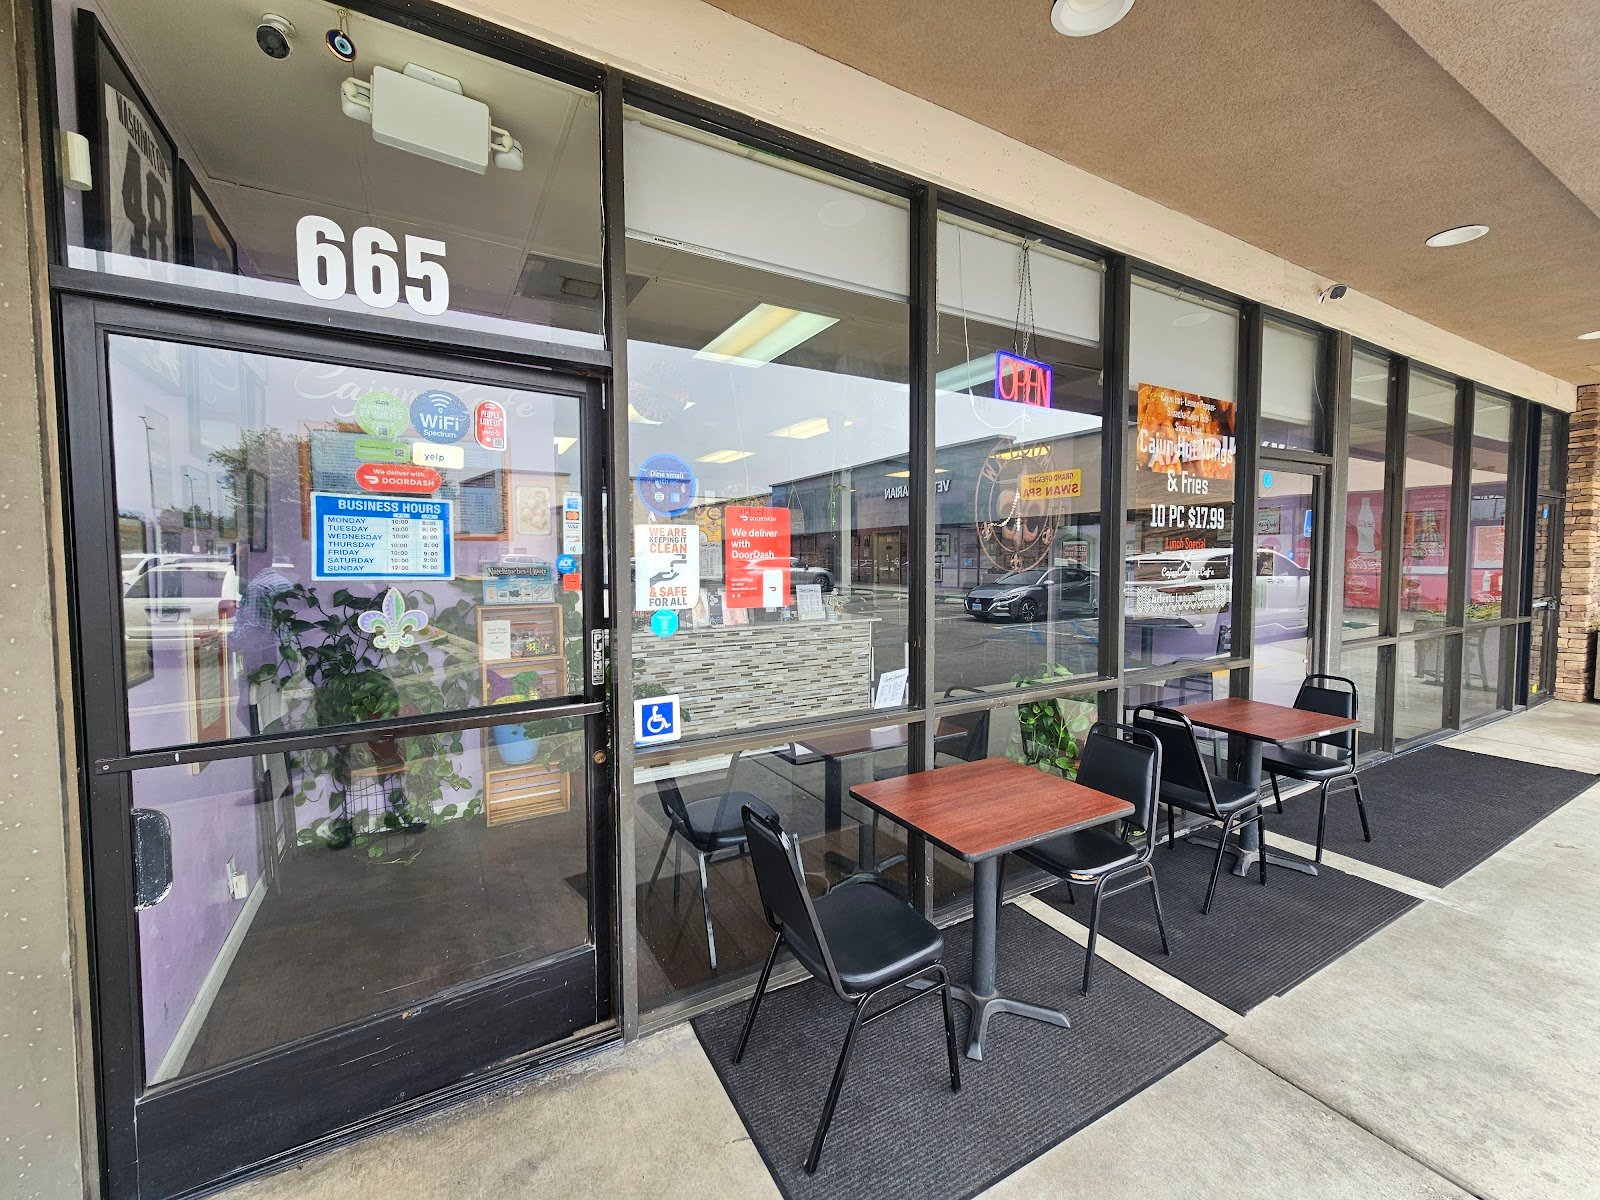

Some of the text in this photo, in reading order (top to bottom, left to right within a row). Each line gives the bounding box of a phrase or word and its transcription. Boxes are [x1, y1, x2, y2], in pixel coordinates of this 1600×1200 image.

[296, 215, 449, 316] 665
[999, 357, 1050, 409] OPEN
[481, 410, 500, 419] PEOPLE
[420, 413, 459, 431] WiFi
[480, 418, 494, 426] LOVE
[424, 429, 456, 439] Spectrum
[1140, 429, 1174, 459] Cajun
[424, 453, 445, 462] yelp
[410, 470, 425, 478] with
[666, 472, 684, 480] small
[382, 477, 435, 487] DOORDASH
[1168, 470, 1208, 494] & Fries
[338, 499, 441, 514] BUSINESS HOURS
[1150, 504, 1224, 529] 10 PC $17.99
[649, 527, 686, 537] WE ARE
[731, 528, 778, 537] We deliver
[650, 544, 687, 554] CLEAN
[731, 540, 750, 548] with
[1165, 538, 1205, 550] Lunch Special
[731, 550, 774, 559] DoorDash
[558, 559, 574, 567] ADT
[1162, 566, 1177, 579] Cajun
[649, 587, 687, 597] & SAFE
[649, 597, 687, 608] FOR ALL
[593, 633, 602, 670] PUSH
